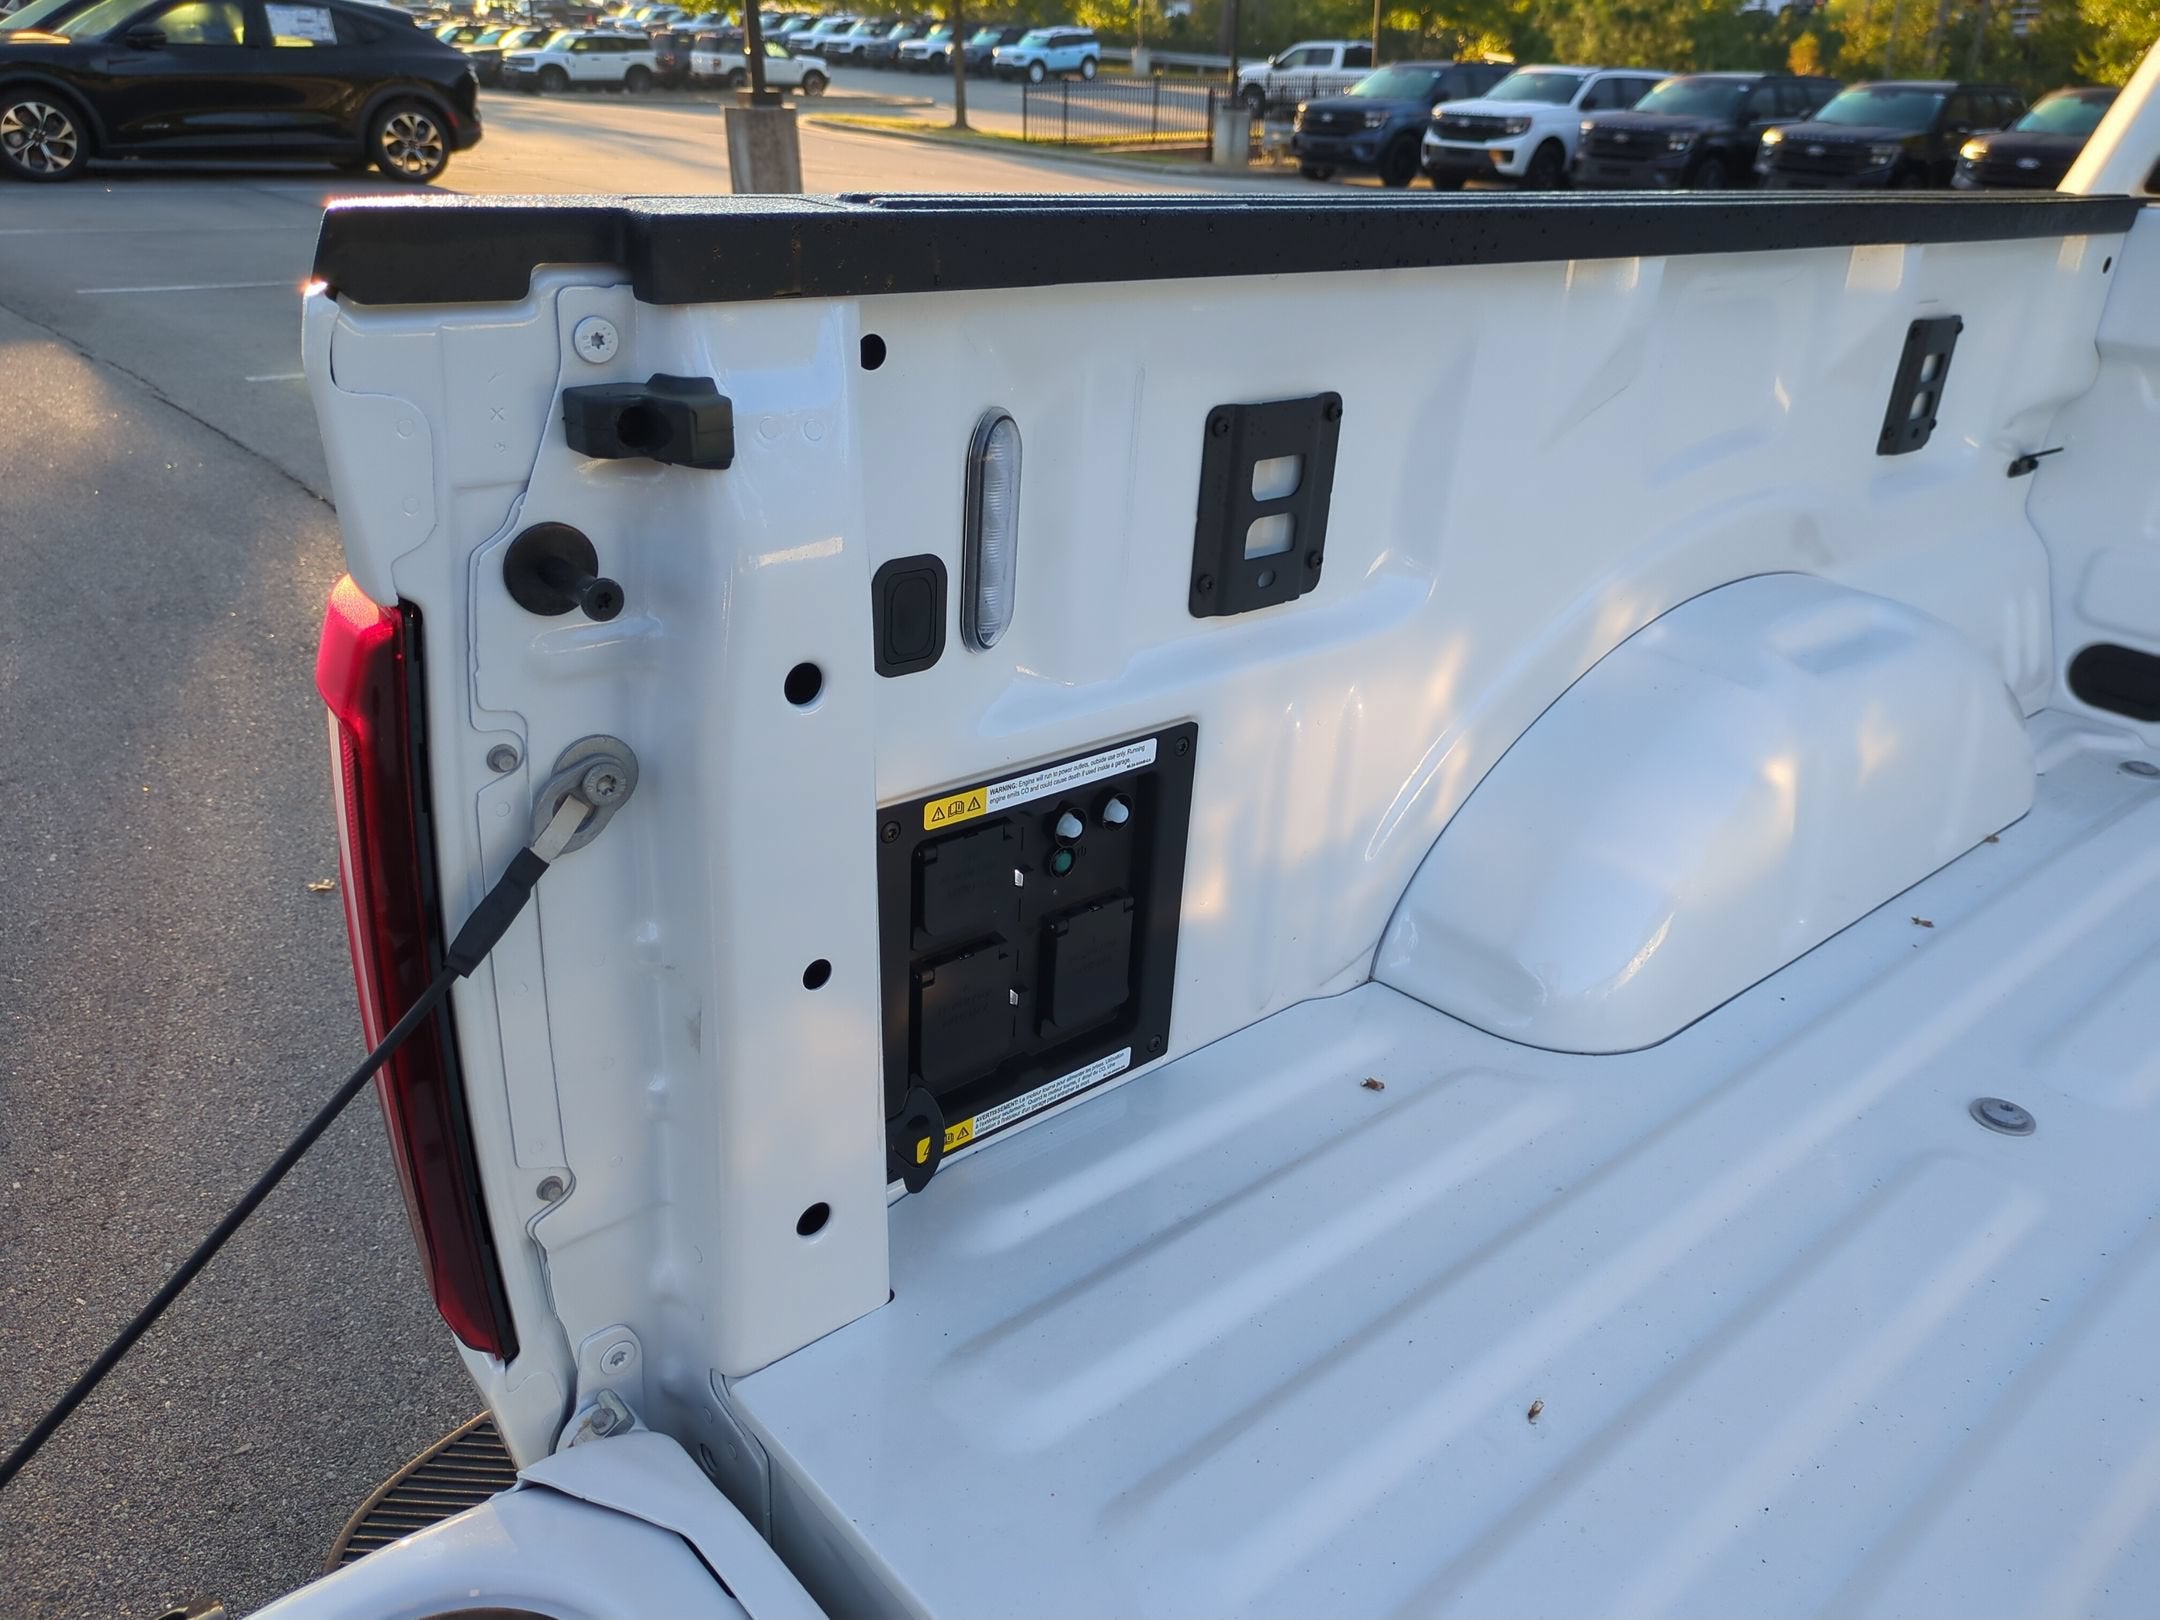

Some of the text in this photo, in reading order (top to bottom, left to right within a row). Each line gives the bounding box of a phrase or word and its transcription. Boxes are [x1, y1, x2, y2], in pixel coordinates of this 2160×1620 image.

[989, 782, 1017, 795] WARNING:
[1018, 778, 1034, 788] Engine
[1058, 767, 1072, 776] power
[1127, 745, 1145, 755] Running
[989, 795, 1005, 805] engine
[1039, 780, 1052, 789] could
